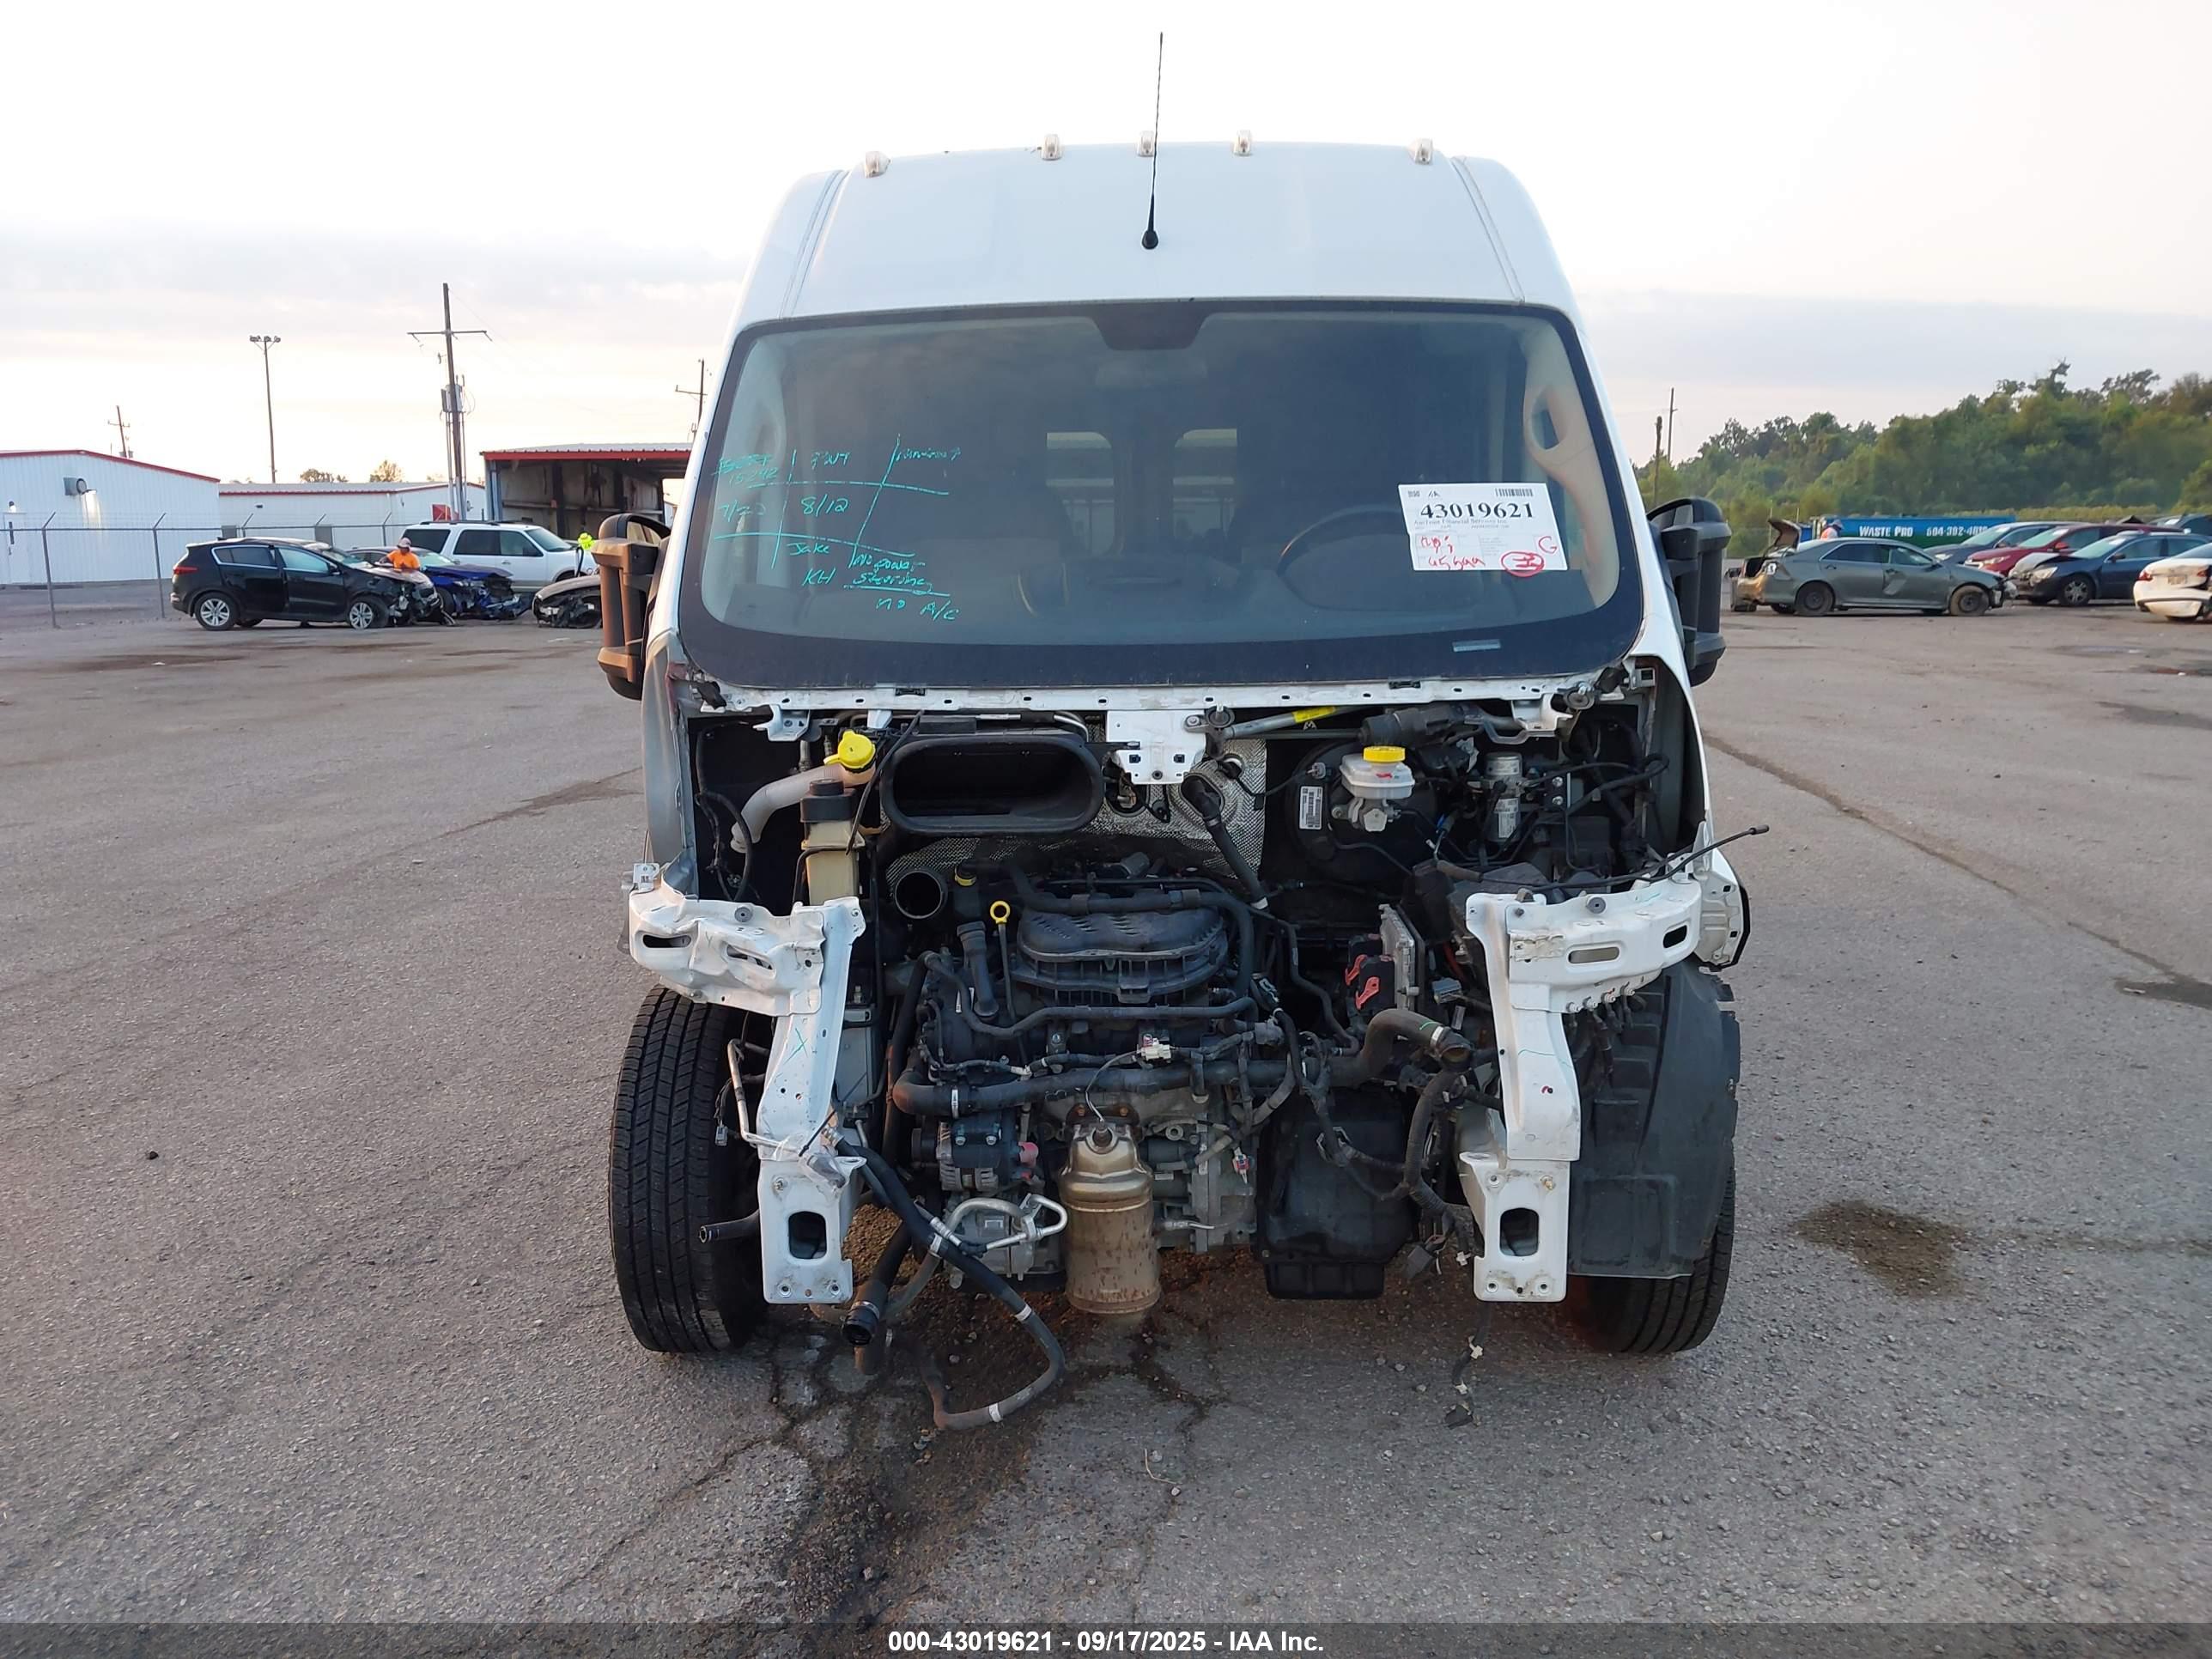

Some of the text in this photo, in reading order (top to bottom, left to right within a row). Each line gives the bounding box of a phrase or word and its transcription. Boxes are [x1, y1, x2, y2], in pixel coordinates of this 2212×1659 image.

[800, 494, 848, 517] 8/12
[1419, 502, 1534, 519] 43019621
[1538, 536, 1558, 555] G
